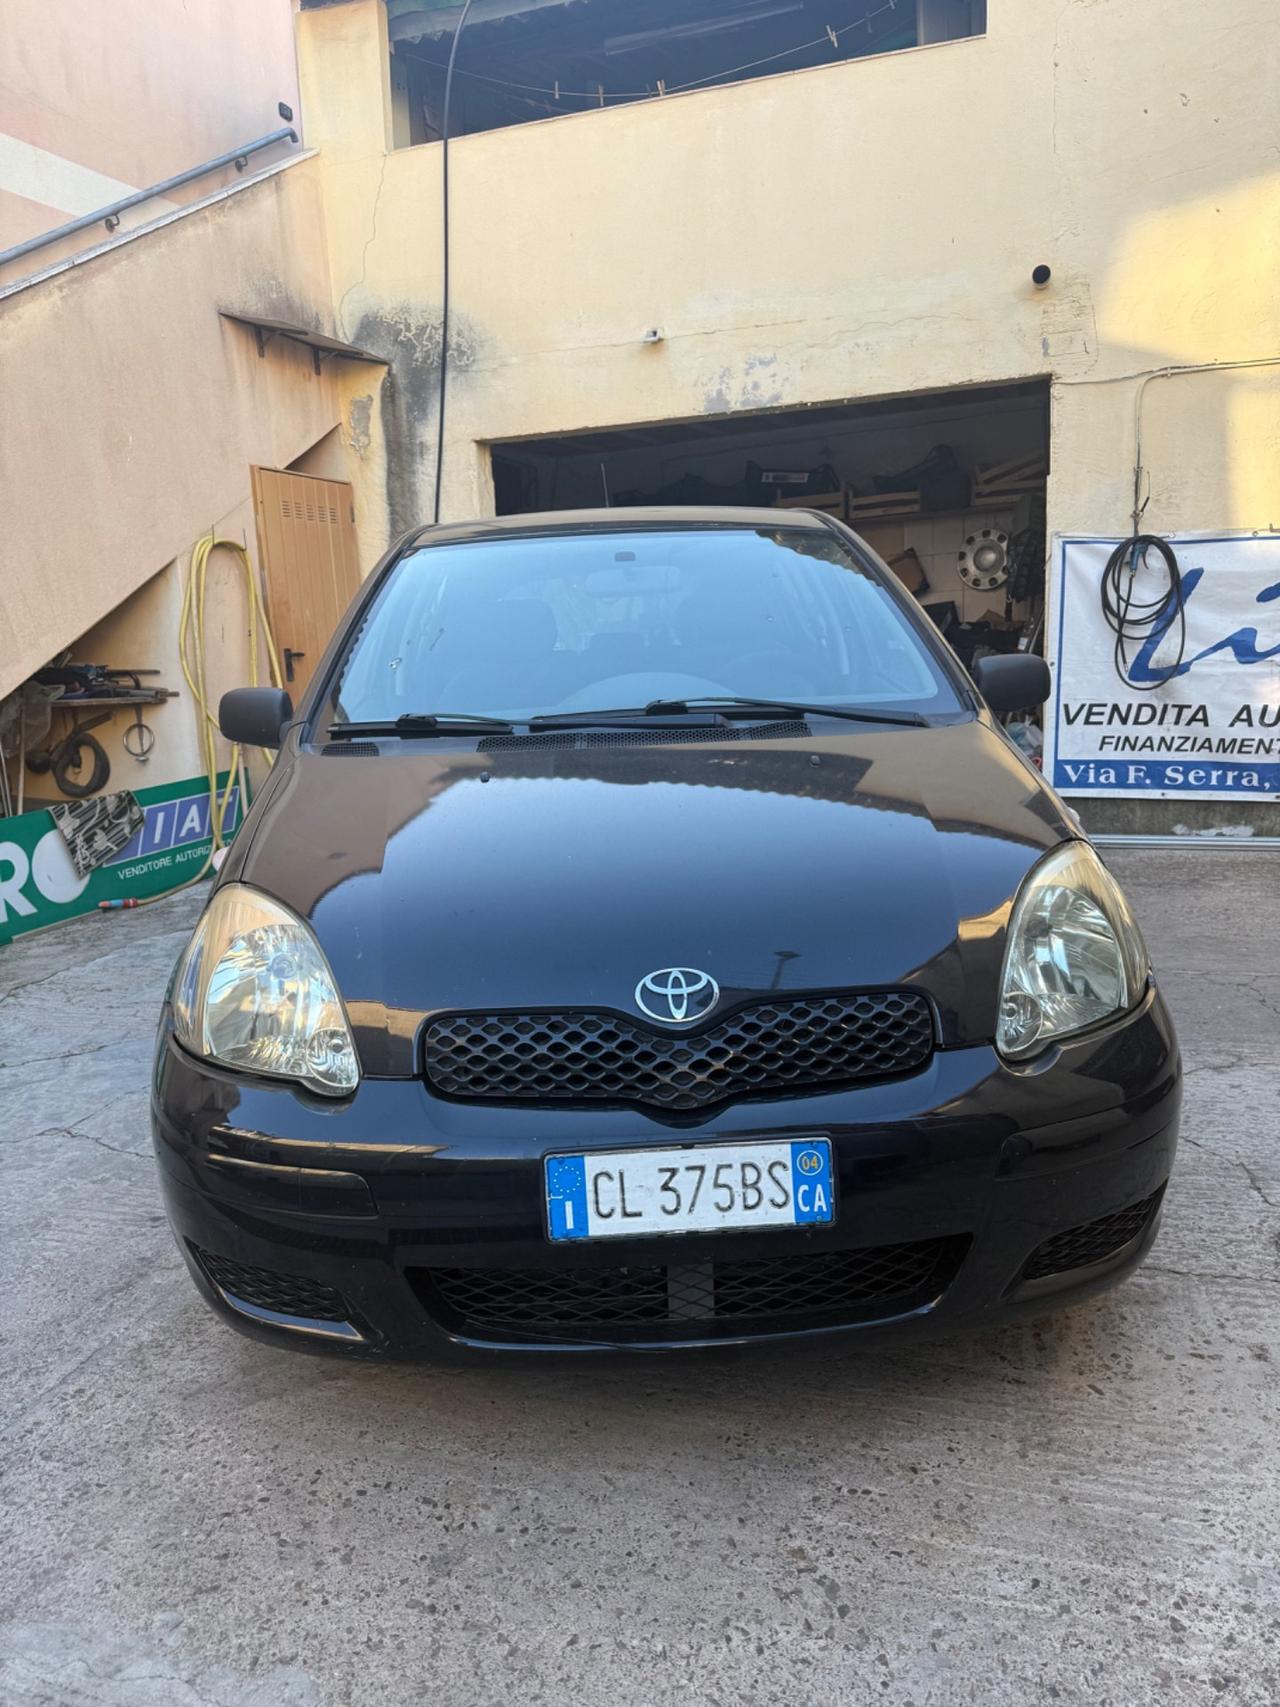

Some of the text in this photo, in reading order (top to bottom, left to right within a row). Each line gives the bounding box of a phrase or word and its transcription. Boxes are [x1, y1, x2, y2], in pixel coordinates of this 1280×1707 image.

[1063, 703, 1280, 728] VENDITA AU
[1064, 764, 1271, 790] Via F. Serra,
[118, 856, 172, 880] VENDITORE
[801, 1155, 819, 1170] 04
[593, 1170, 643, 1219] CL
[658, 1161, 790, 1215] 375BS
[797, 1183, 827, 1213] CA
